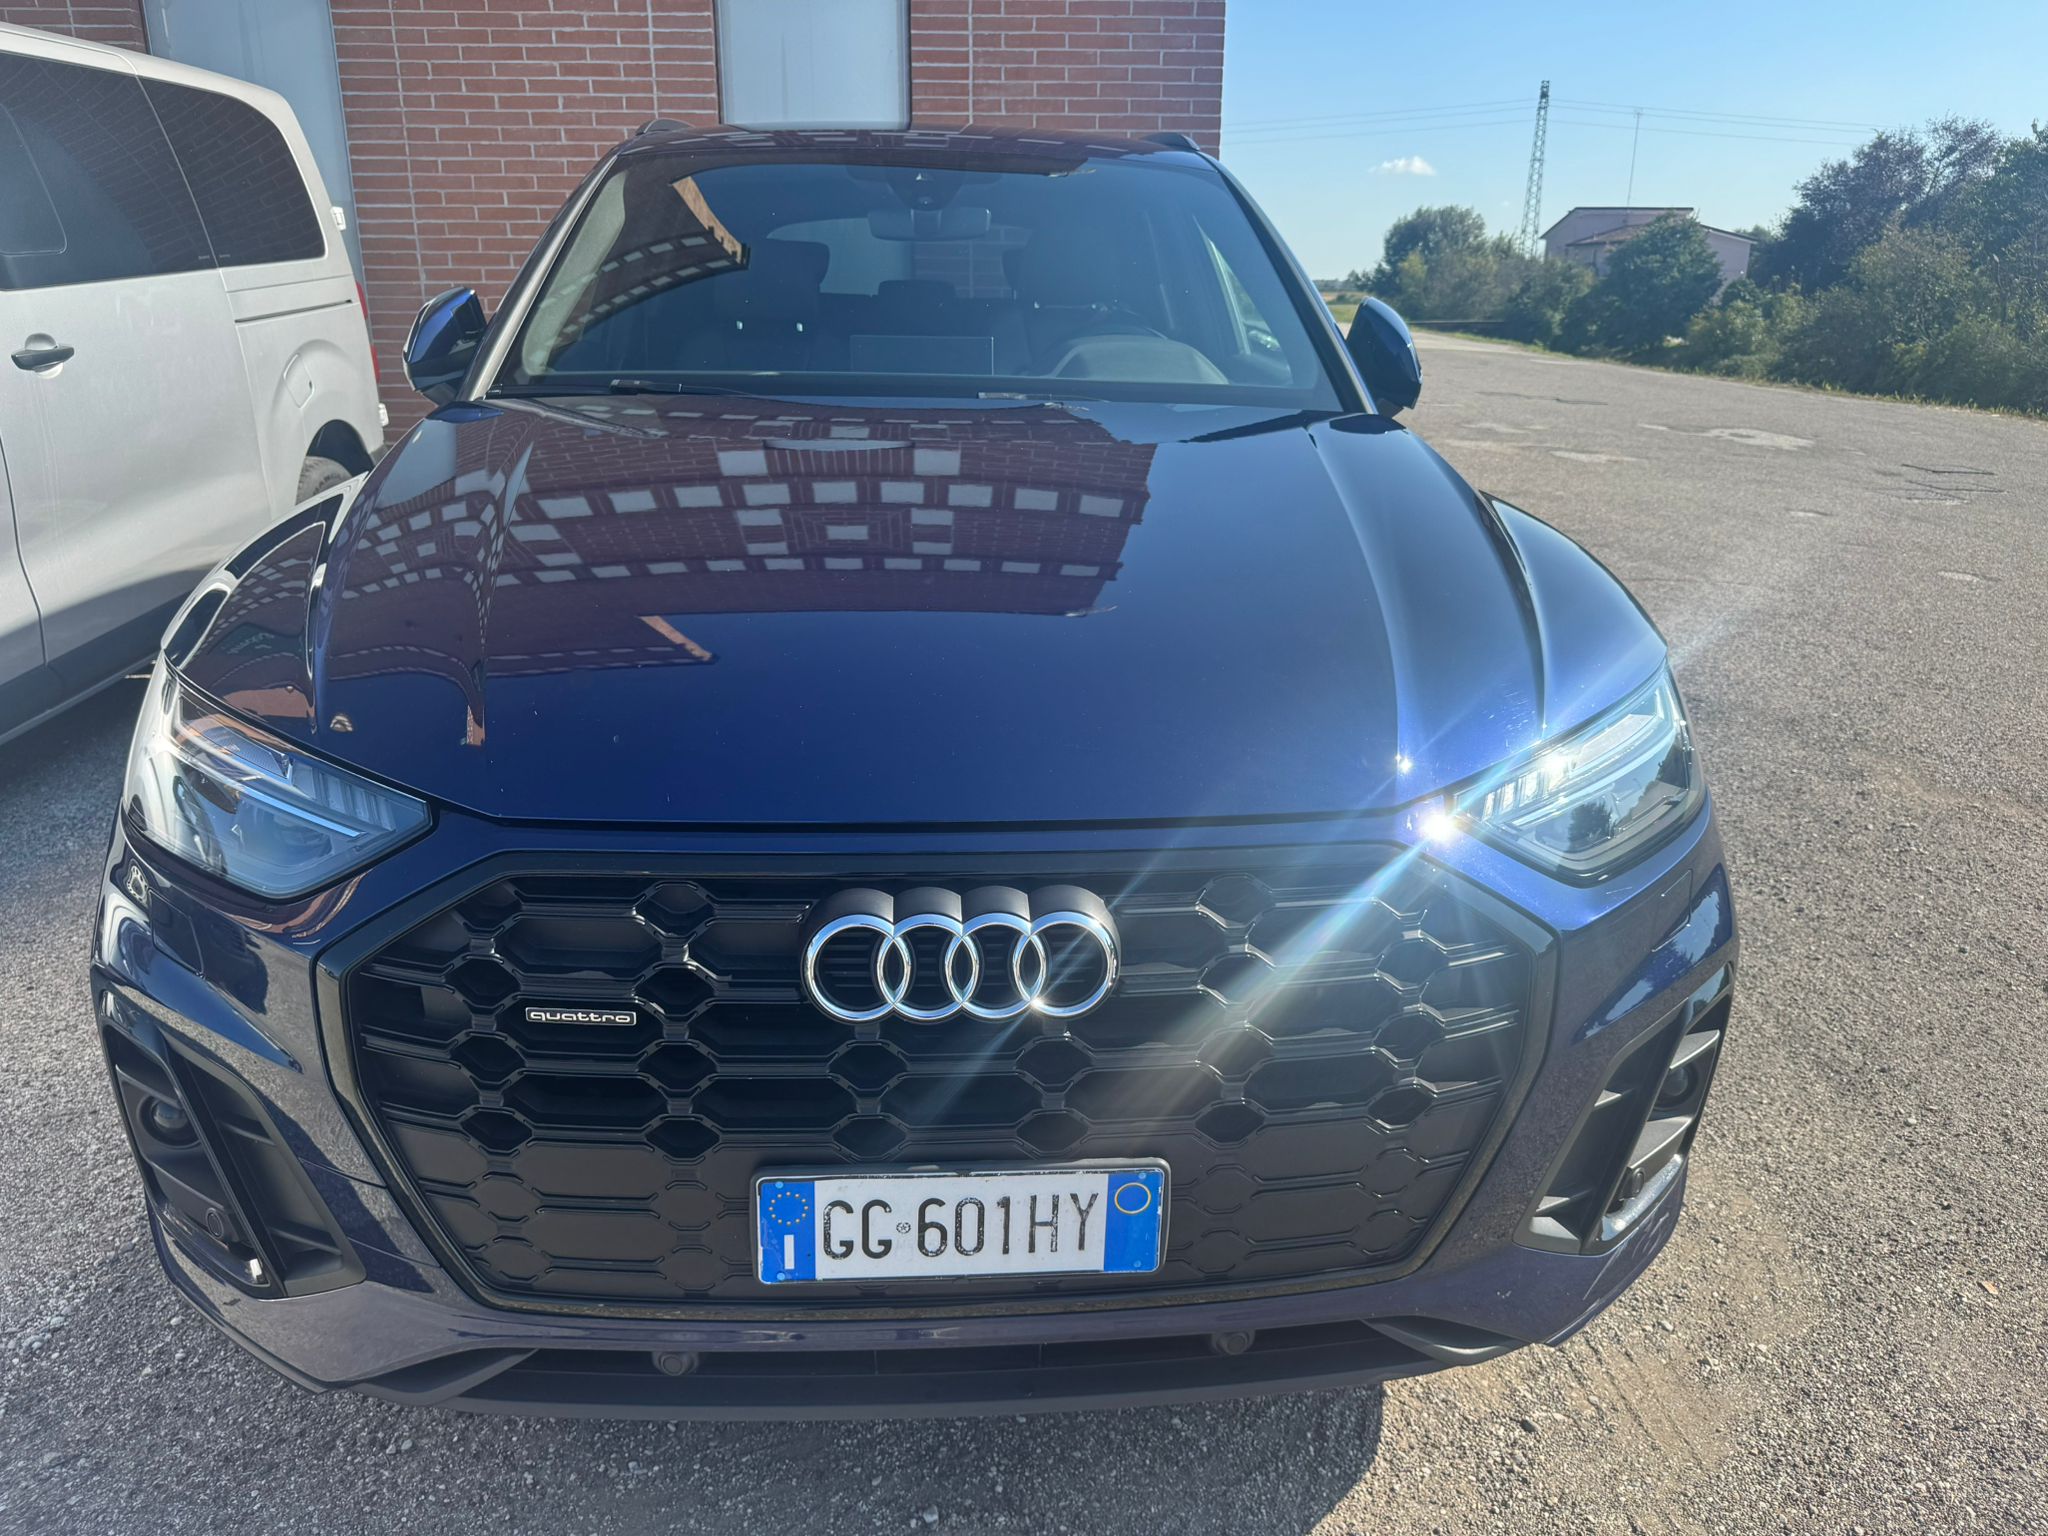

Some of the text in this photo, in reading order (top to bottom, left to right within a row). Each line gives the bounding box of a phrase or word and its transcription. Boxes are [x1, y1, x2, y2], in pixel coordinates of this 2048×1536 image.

[530, 1011, 631, 1023] quattro
[823, 1192, 1099, 1261] GG 601HY
